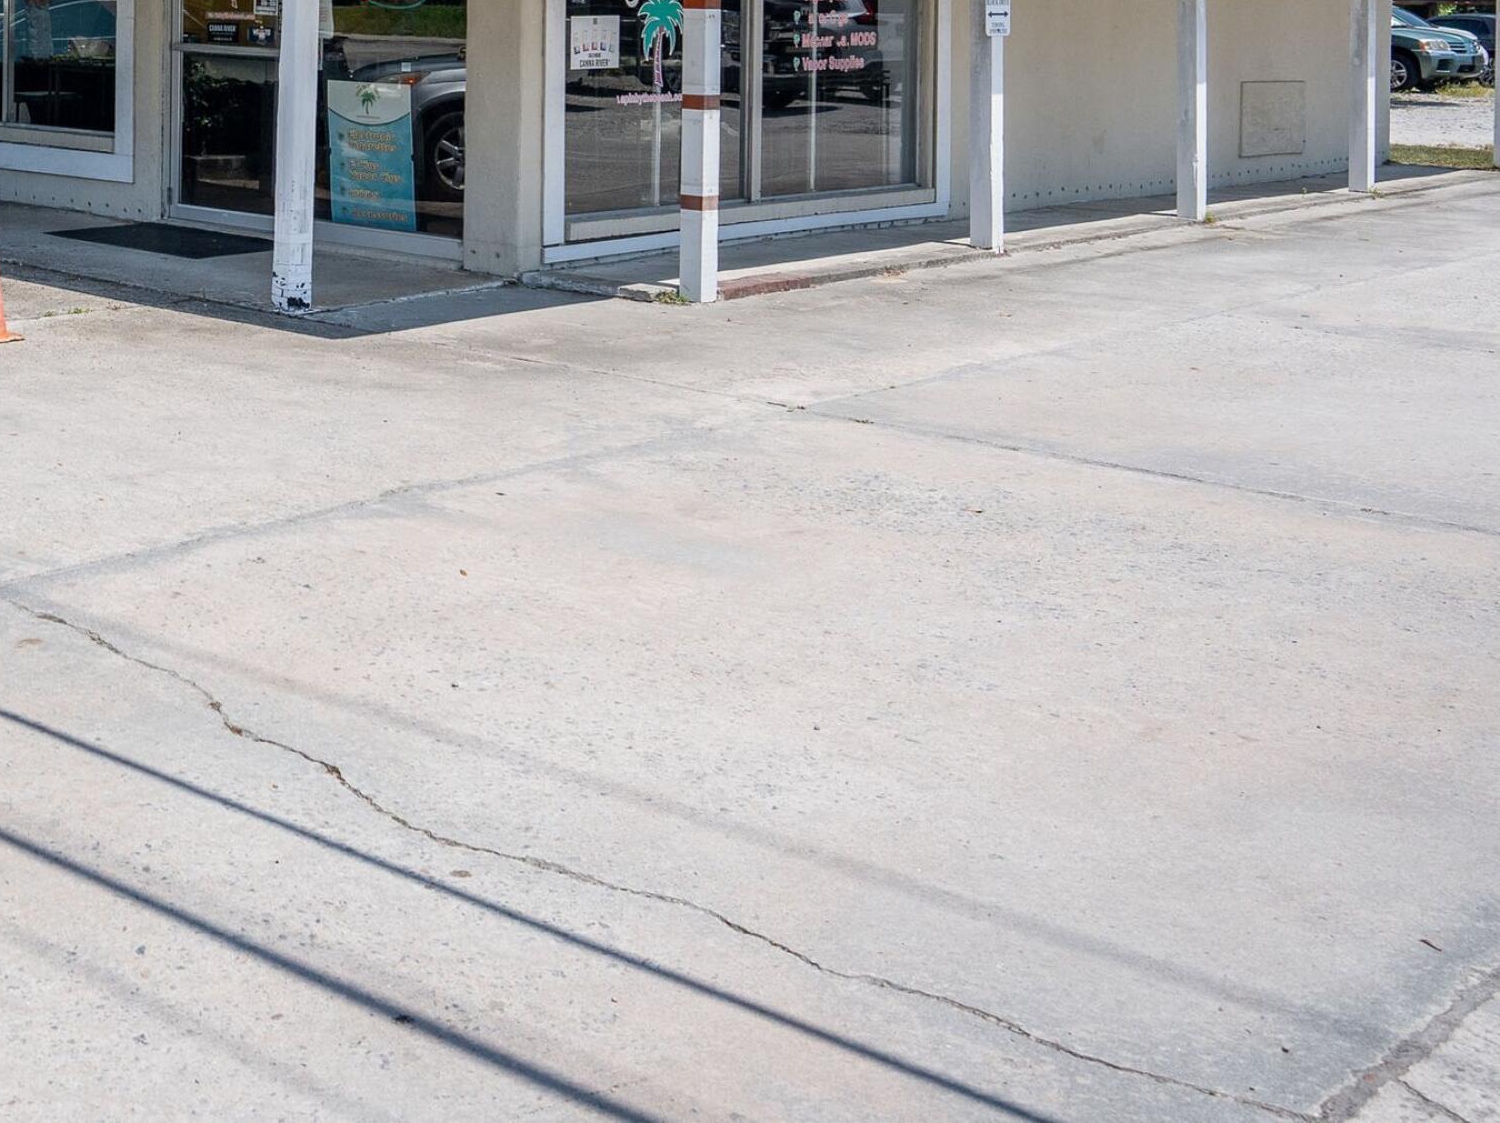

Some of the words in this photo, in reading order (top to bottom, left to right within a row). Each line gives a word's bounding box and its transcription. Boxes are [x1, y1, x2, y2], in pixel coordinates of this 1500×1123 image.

[850, 31, 877, 47] MODS
[595, 58, 610, 67] RIVER
[801, 56, 828, 71] Vapor
[828, 55, 865, 73] Supplies
